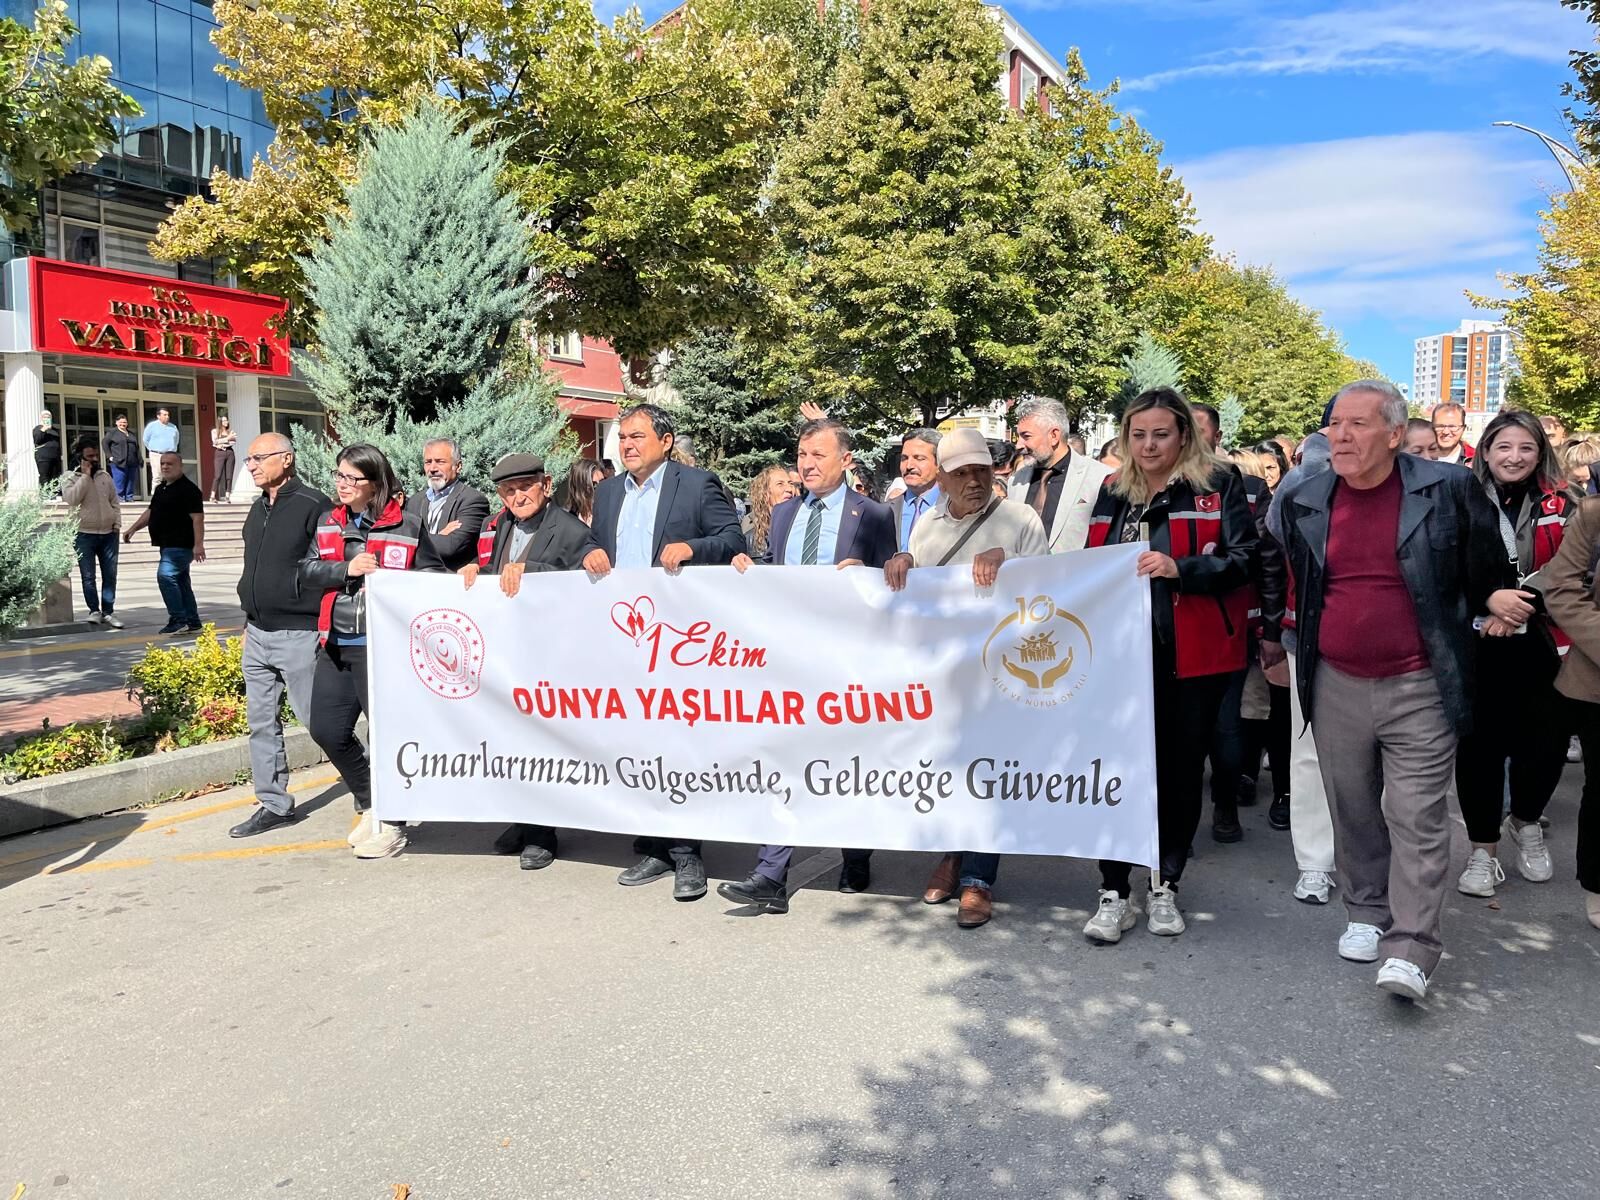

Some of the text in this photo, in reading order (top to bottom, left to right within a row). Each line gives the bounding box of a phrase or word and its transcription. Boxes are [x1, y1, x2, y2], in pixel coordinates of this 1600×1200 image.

[109, 300, 231, 330] KIRŞEHİR
[149, 286, 191, 305] T.C.
[59, 319, 271, 366] VALİLİĞİ
[646, 621, 767, 673] 1 Ekim
[513, 681, 933, 727] DÜNYA YAŞLILAR GÜNÜ
[397, 741, 1122, 814] Çınarlarımızın Gölgesinde, Geleceğe Güvenle
